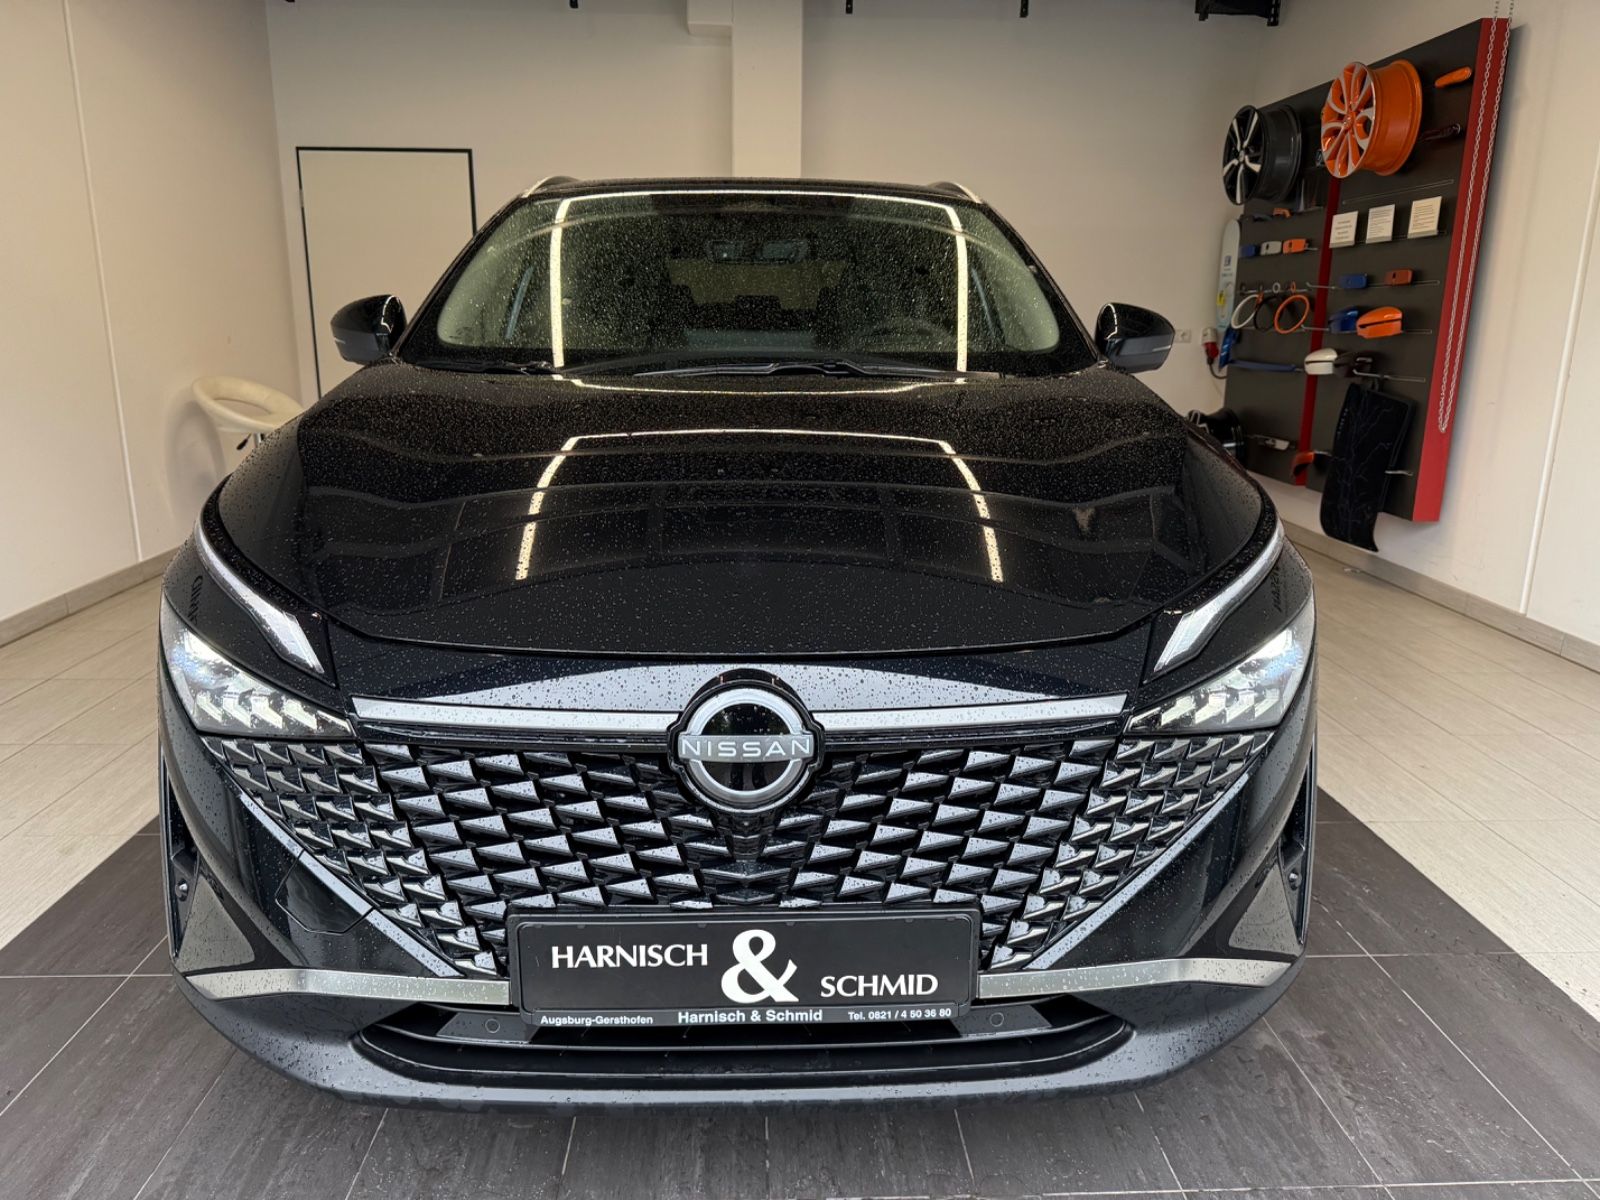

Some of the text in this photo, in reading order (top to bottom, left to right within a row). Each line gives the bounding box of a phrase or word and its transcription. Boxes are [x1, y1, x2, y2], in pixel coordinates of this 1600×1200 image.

[681, 739, 810, 758] NISSAN
[551, 929, 939, 1004] HARNISCH & SCHMID
[540, 1015, 654, 1027] Augsburg-Gersthofen
[678, 1009, 823, 1024] Harnisch & Schmid
[848, 1011, 866, 1021] Tel.
[868, 1010, 892, 1020] 0821
[901, 1009, 908, 1019] 4
[910, 1009, 922, 1019] 50
